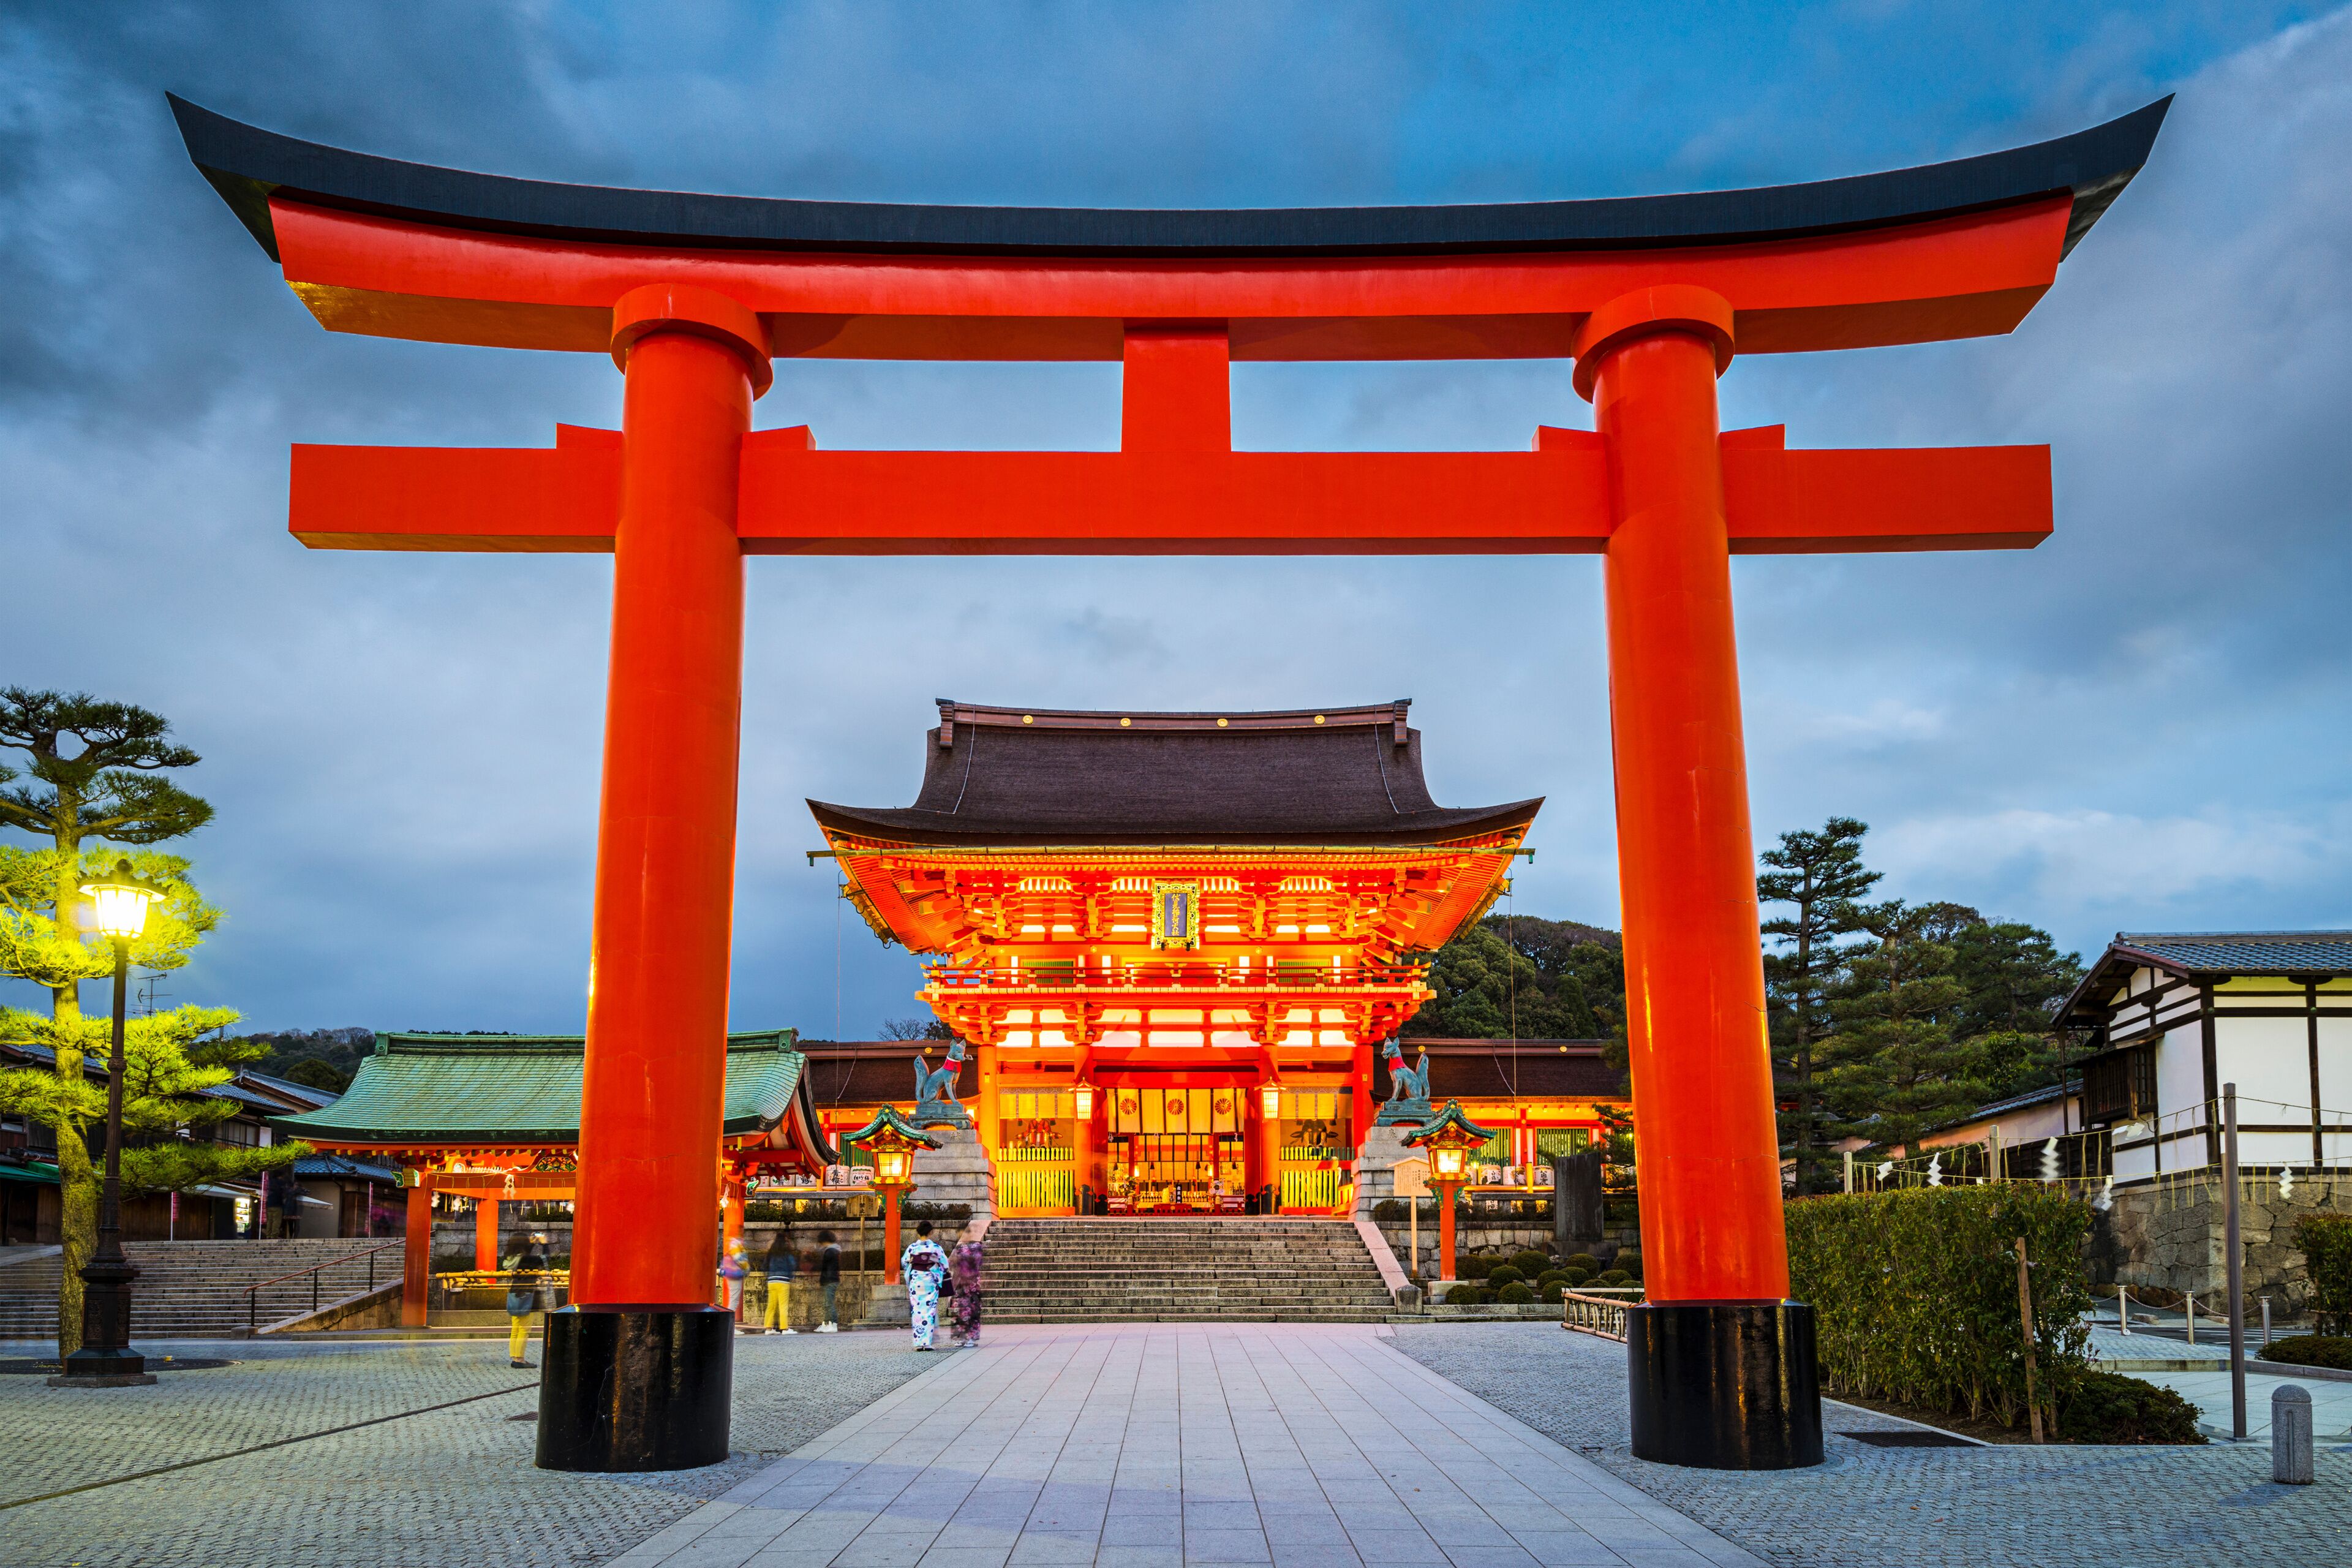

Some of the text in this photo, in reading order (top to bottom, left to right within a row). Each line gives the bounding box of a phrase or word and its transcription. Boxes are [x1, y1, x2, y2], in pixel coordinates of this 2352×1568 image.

[1171, 894, 1181, 936] 伏見稲荷大社
